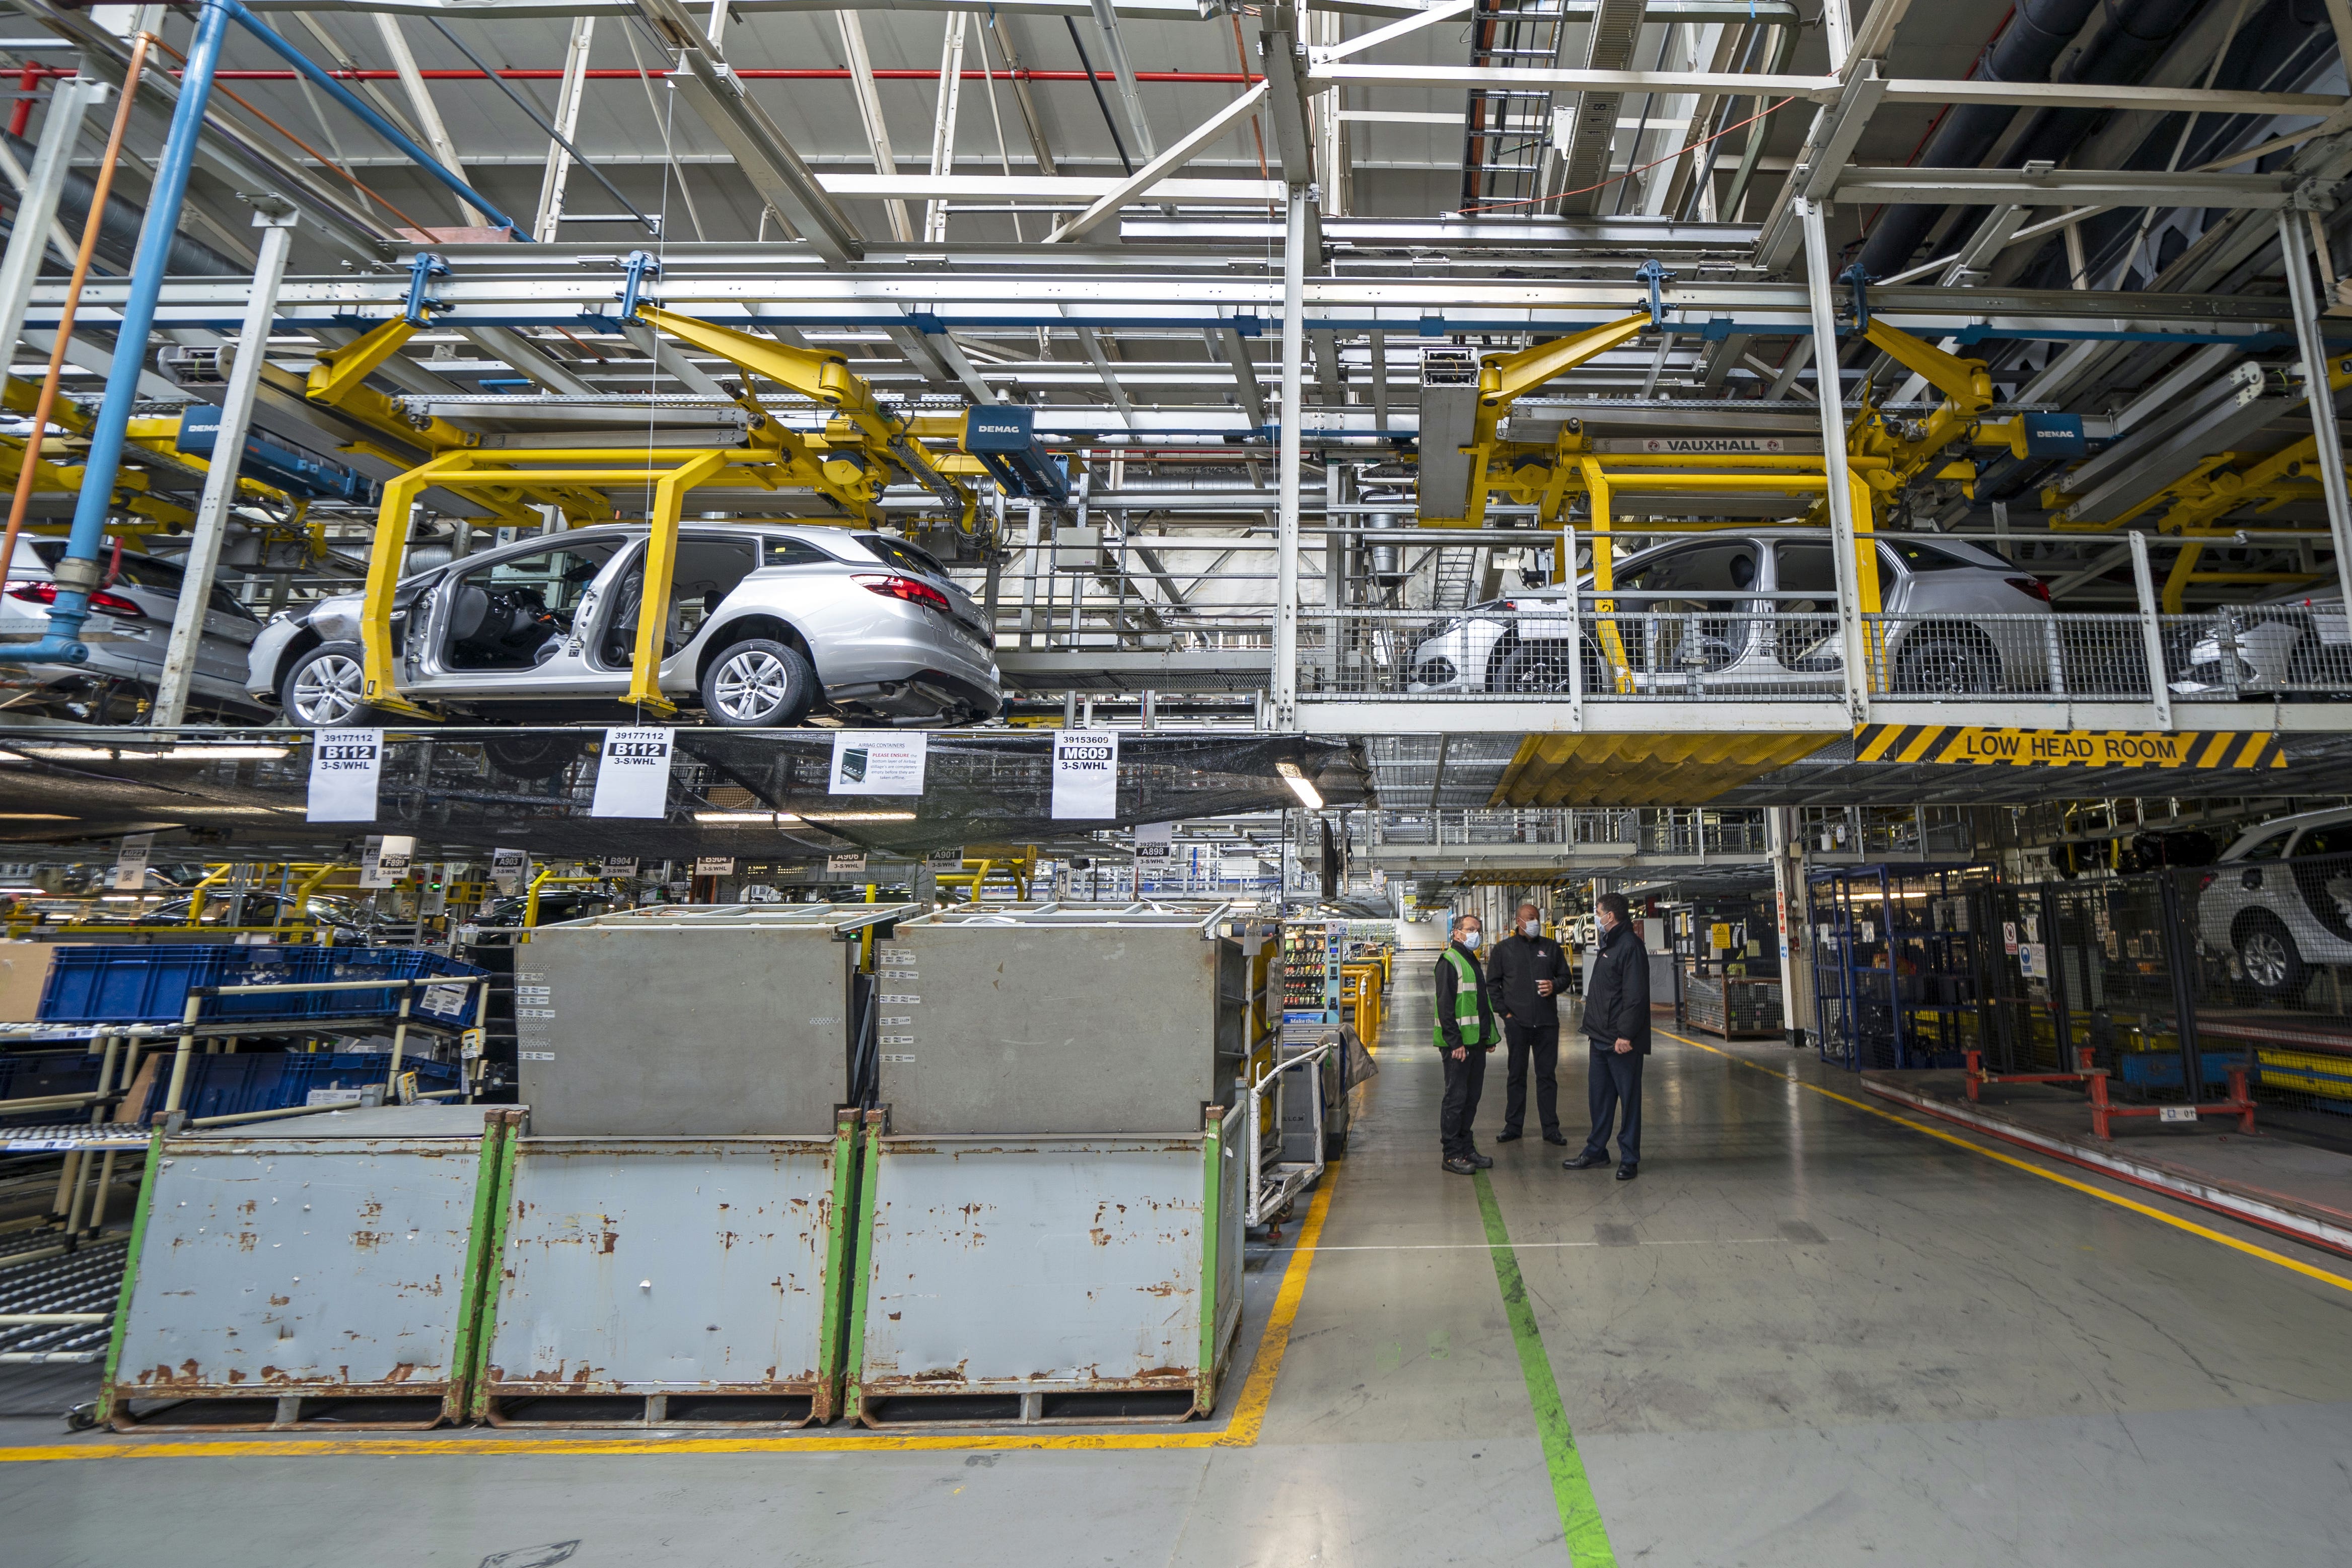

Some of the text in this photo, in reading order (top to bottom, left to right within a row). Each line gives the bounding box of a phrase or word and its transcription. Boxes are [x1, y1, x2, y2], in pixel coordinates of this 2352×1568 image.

[1667, 441, 1760, 451] VAUXHALL
[1036, 470, 1054, 487] DEMAG
[326, 746, 371, 758] B112
[615, 743, 660, 755] B112
[1967, 735, 2177, 758] LOW HEAD ROOM
[1064, 748, 1108, 759] M609
[321, 761, 370, 769] 3-S/WHL
[1061, 762, 1107, 770] 3-S/WHL
